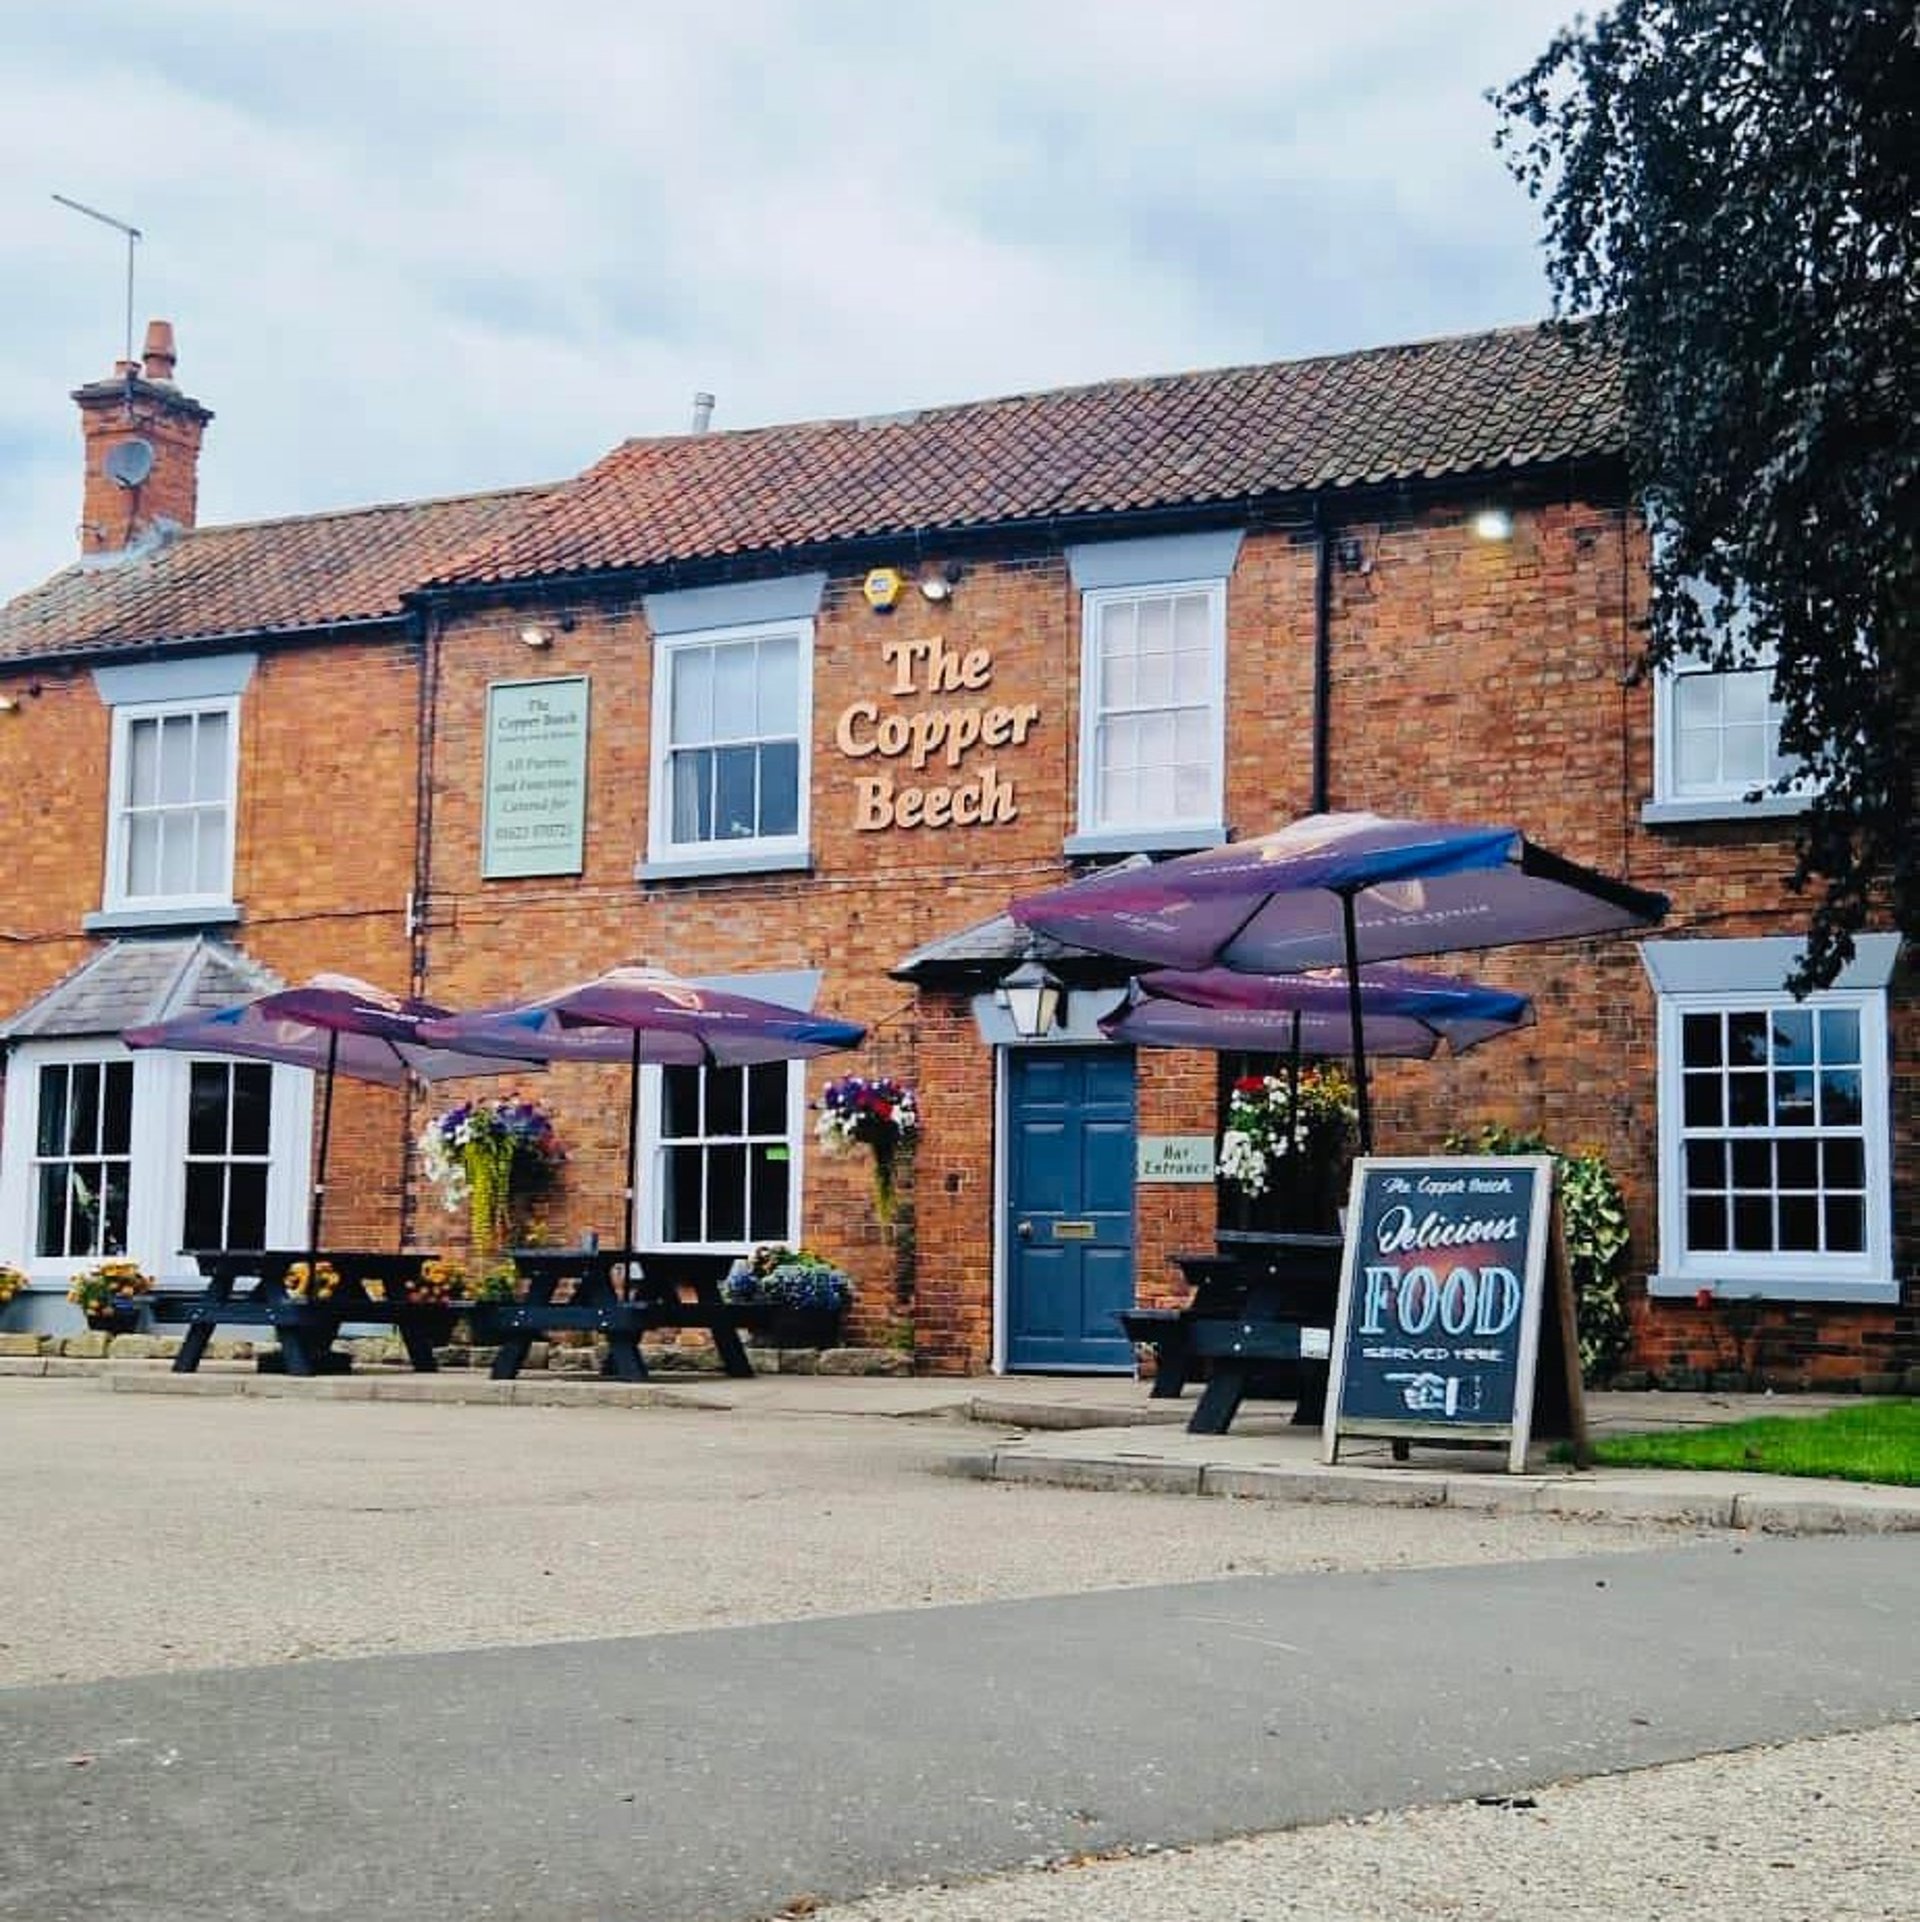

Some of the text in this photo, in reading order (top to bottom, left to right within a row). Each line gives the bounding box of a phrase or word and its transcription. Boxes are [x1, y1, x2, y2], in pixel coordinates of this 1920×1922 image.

[882, 635, 992, 696] The
[528, 699, 550, 711] The
[836, 700, 1039, 770] Copper
[854, 765, 1018, 832] Beech
[1163, 1142, 1190, 1159] Bar
[1144, 1160, 1211, 1175] Entrance
[1381, 1176, 1411, 1194] The
[1376, 1205, 1517, 1253] Delicious
[1359, 1265, 1521, 1336] FOOD
[1362, 1346, 1450, 1361] SERVED
